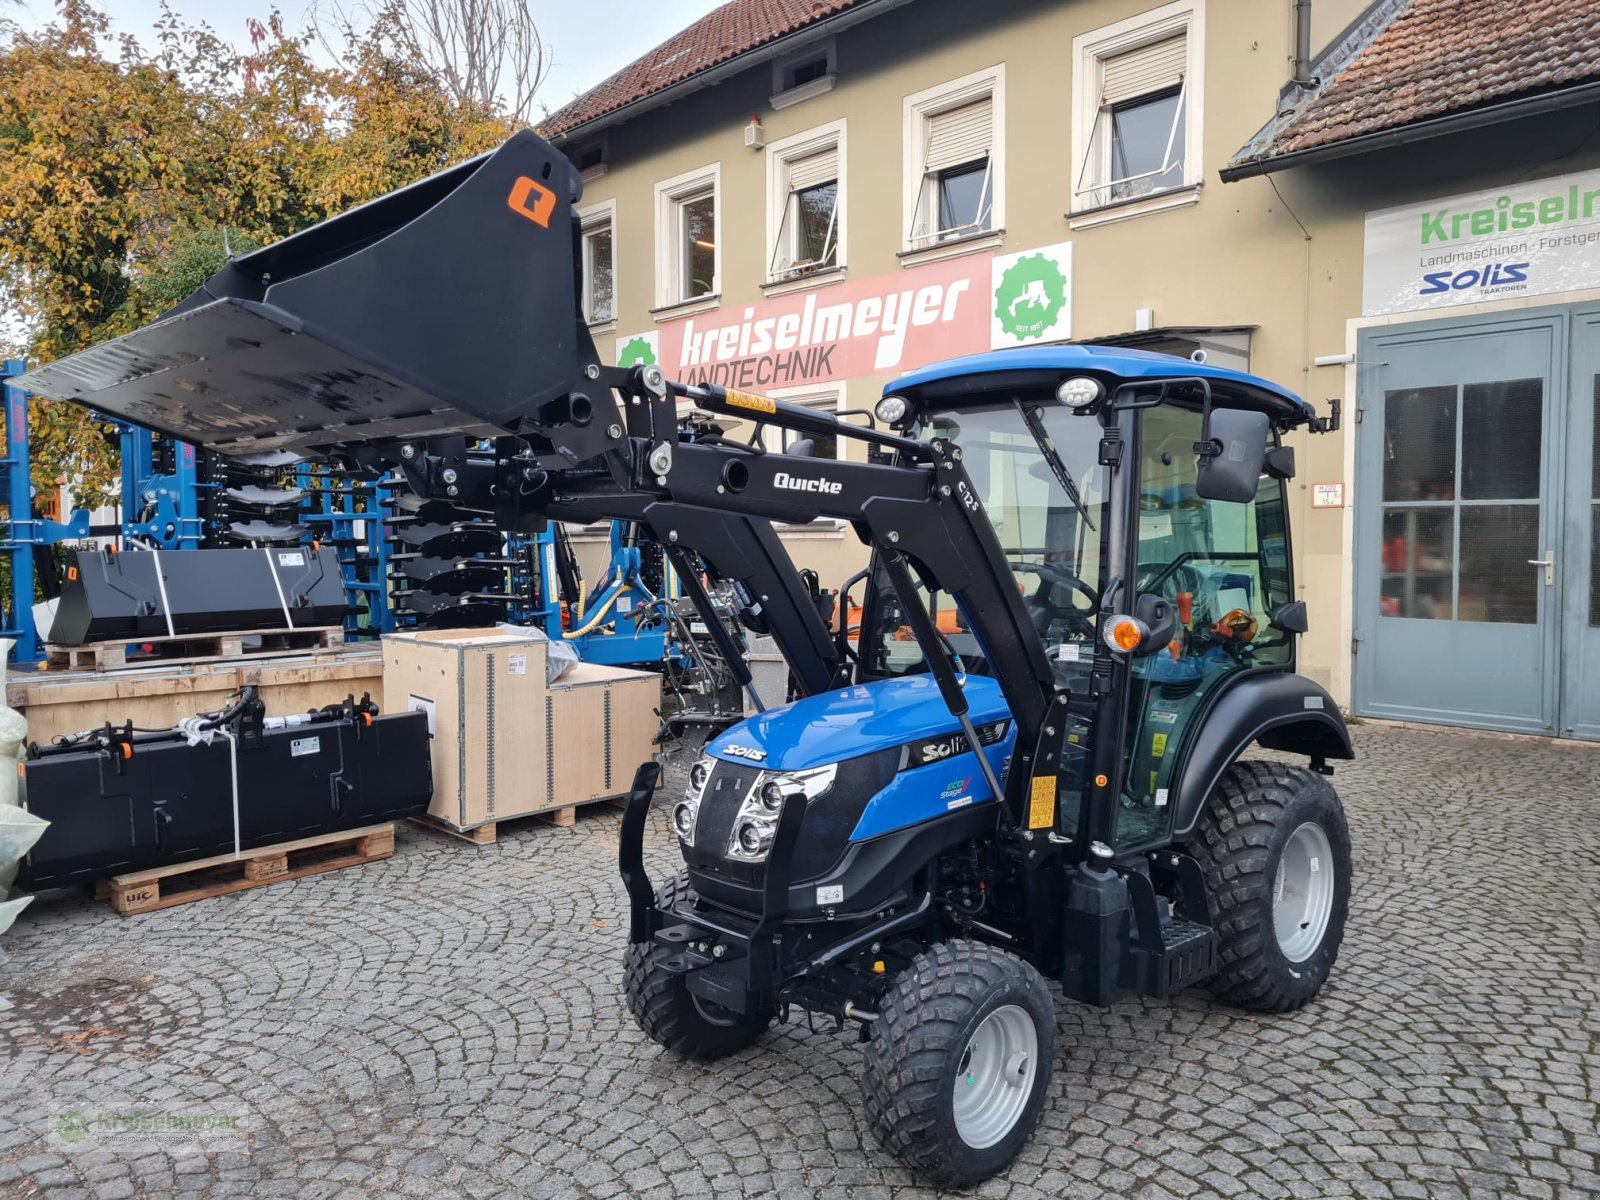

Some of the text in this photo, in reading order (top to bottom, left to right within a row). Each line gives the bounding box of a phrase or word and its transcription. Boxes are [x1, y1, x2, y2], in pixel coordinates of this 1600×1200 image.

[1420, 243, 1527, 268] Landmaschinen
[1480, 284, 1527, 295] TRAKTOREN
[679, 279, 970, 369] kreiselmeyer
[773, 472, 842, 494] Quicke
